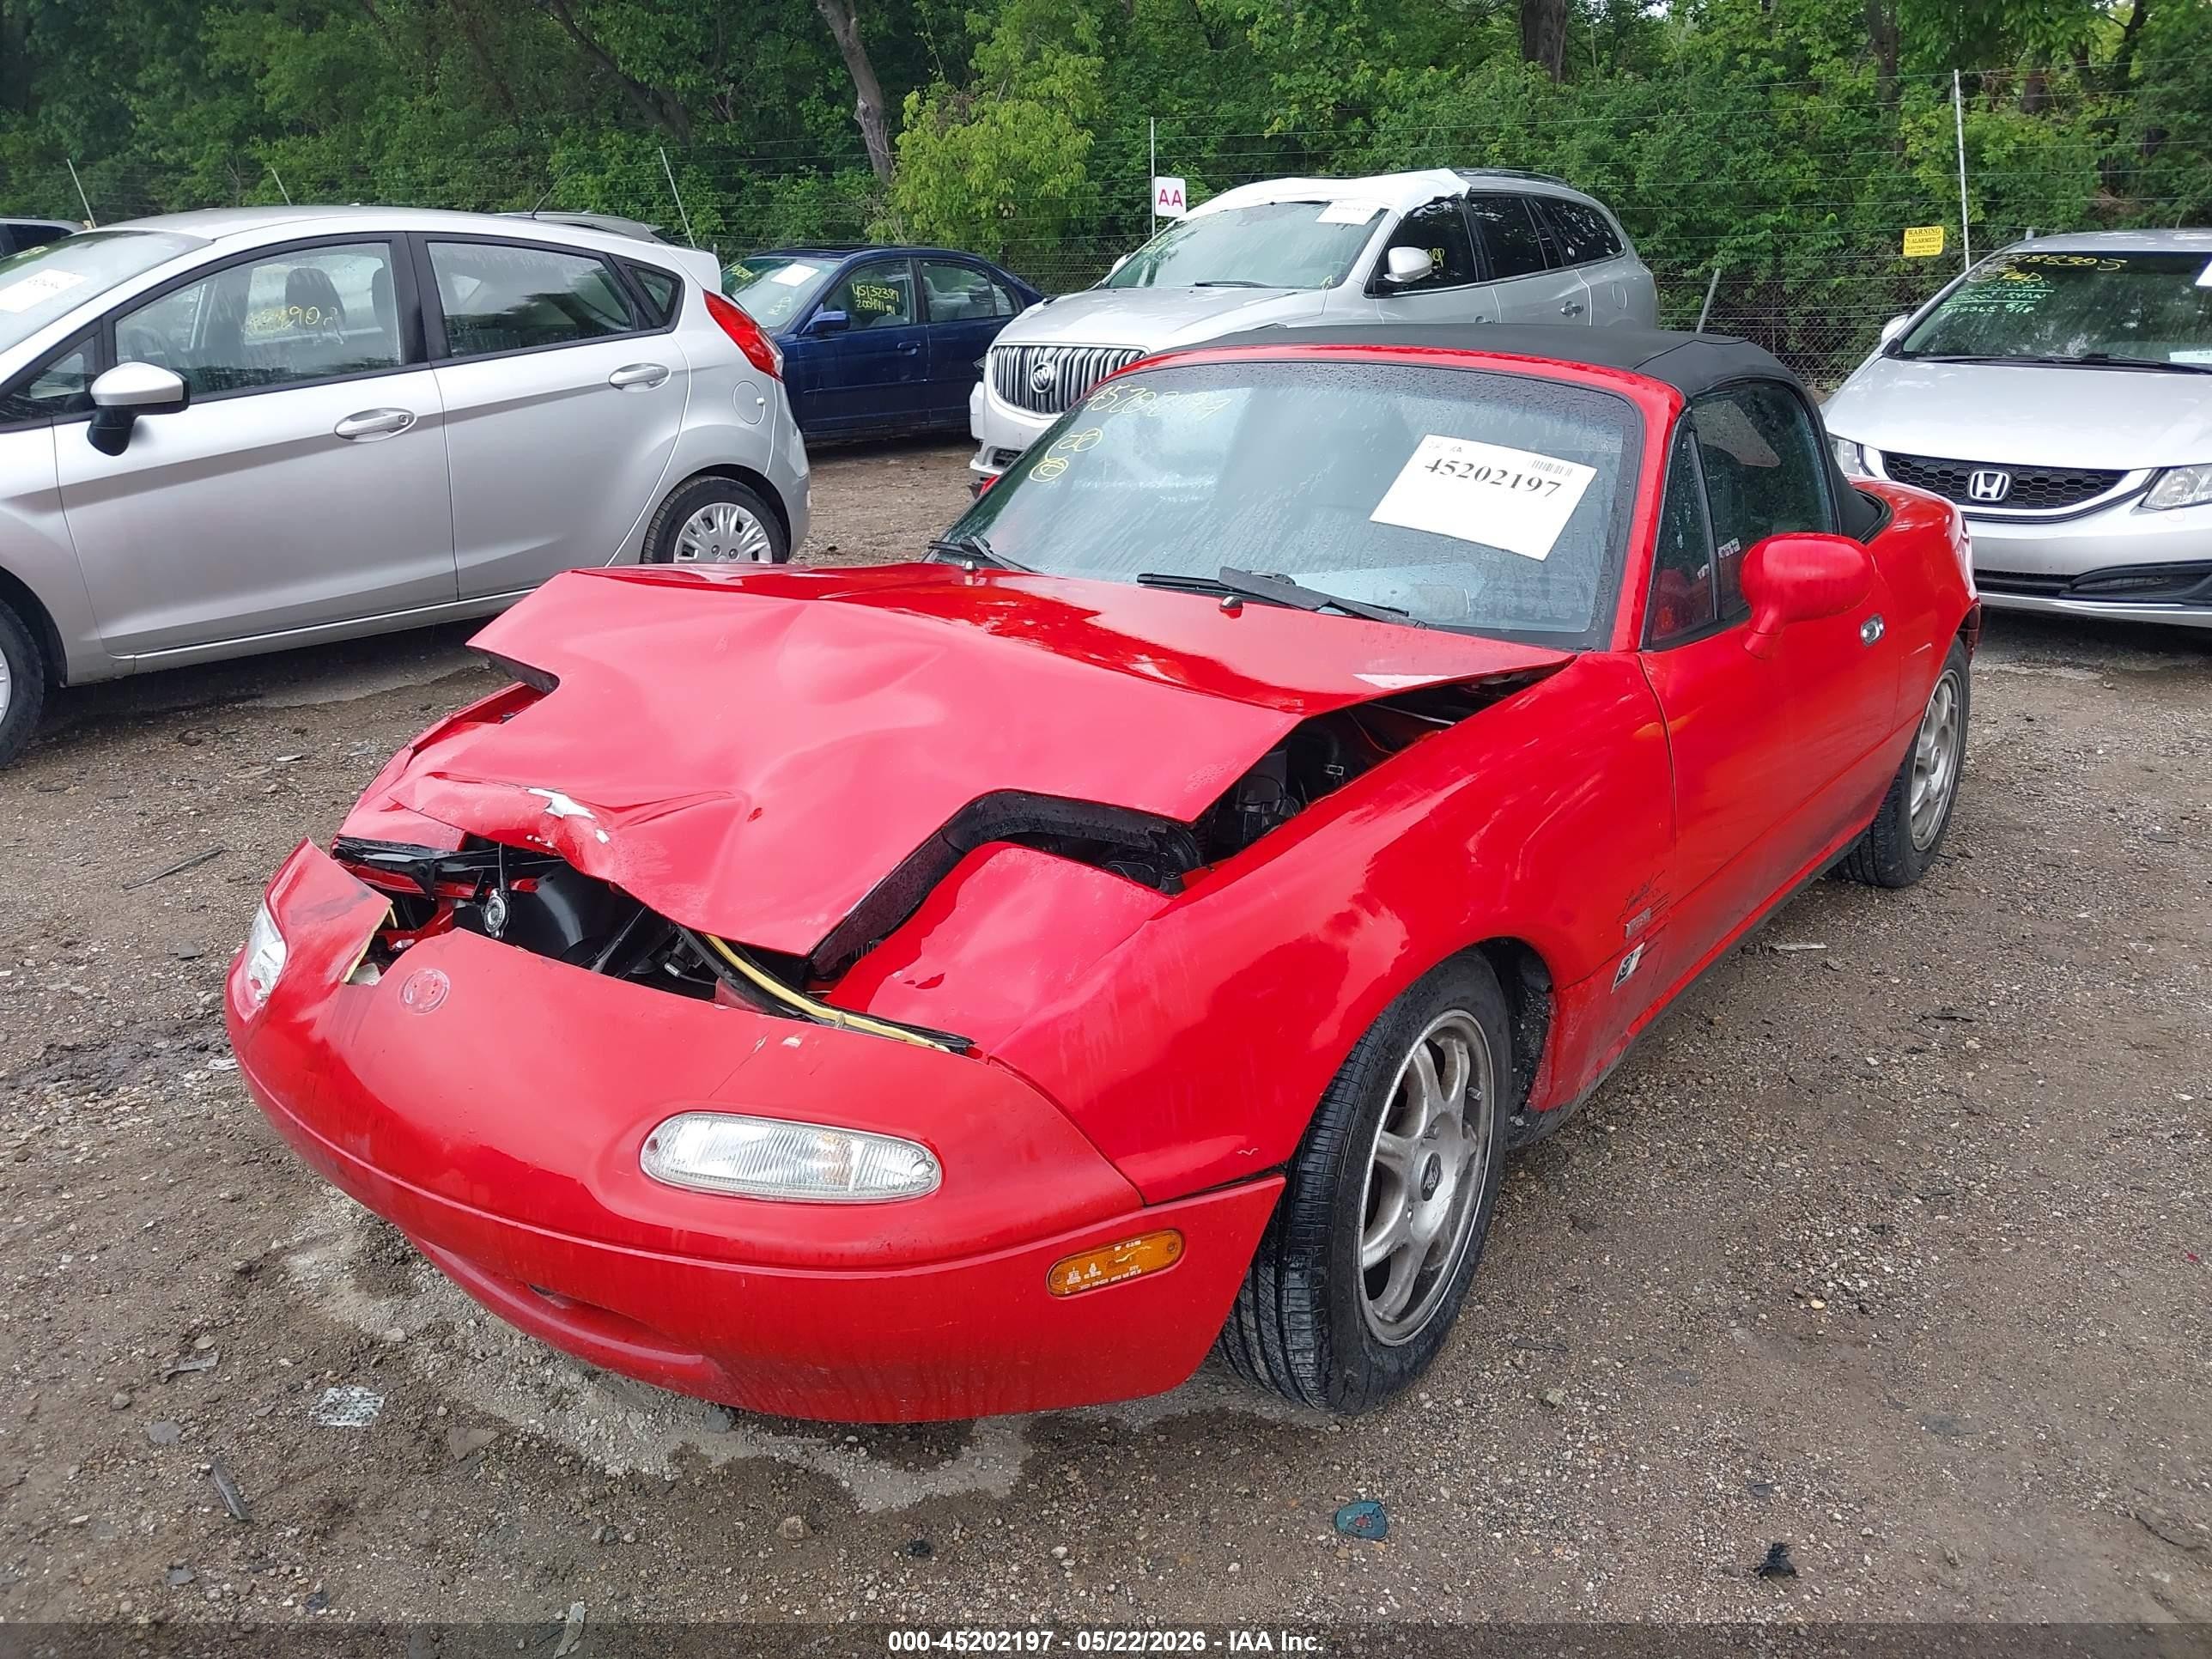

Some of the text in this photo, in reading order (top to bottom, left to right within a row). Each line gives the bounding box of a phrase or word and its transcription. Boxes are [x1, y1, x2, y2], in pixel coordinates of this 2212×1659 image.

[1158, 188, 1183, 207] AA
[1907, 227, 1941, 236] WARNING
[852, 283, 899, 302] 45132389
[1424, 458, 1562, 497] 45202197
